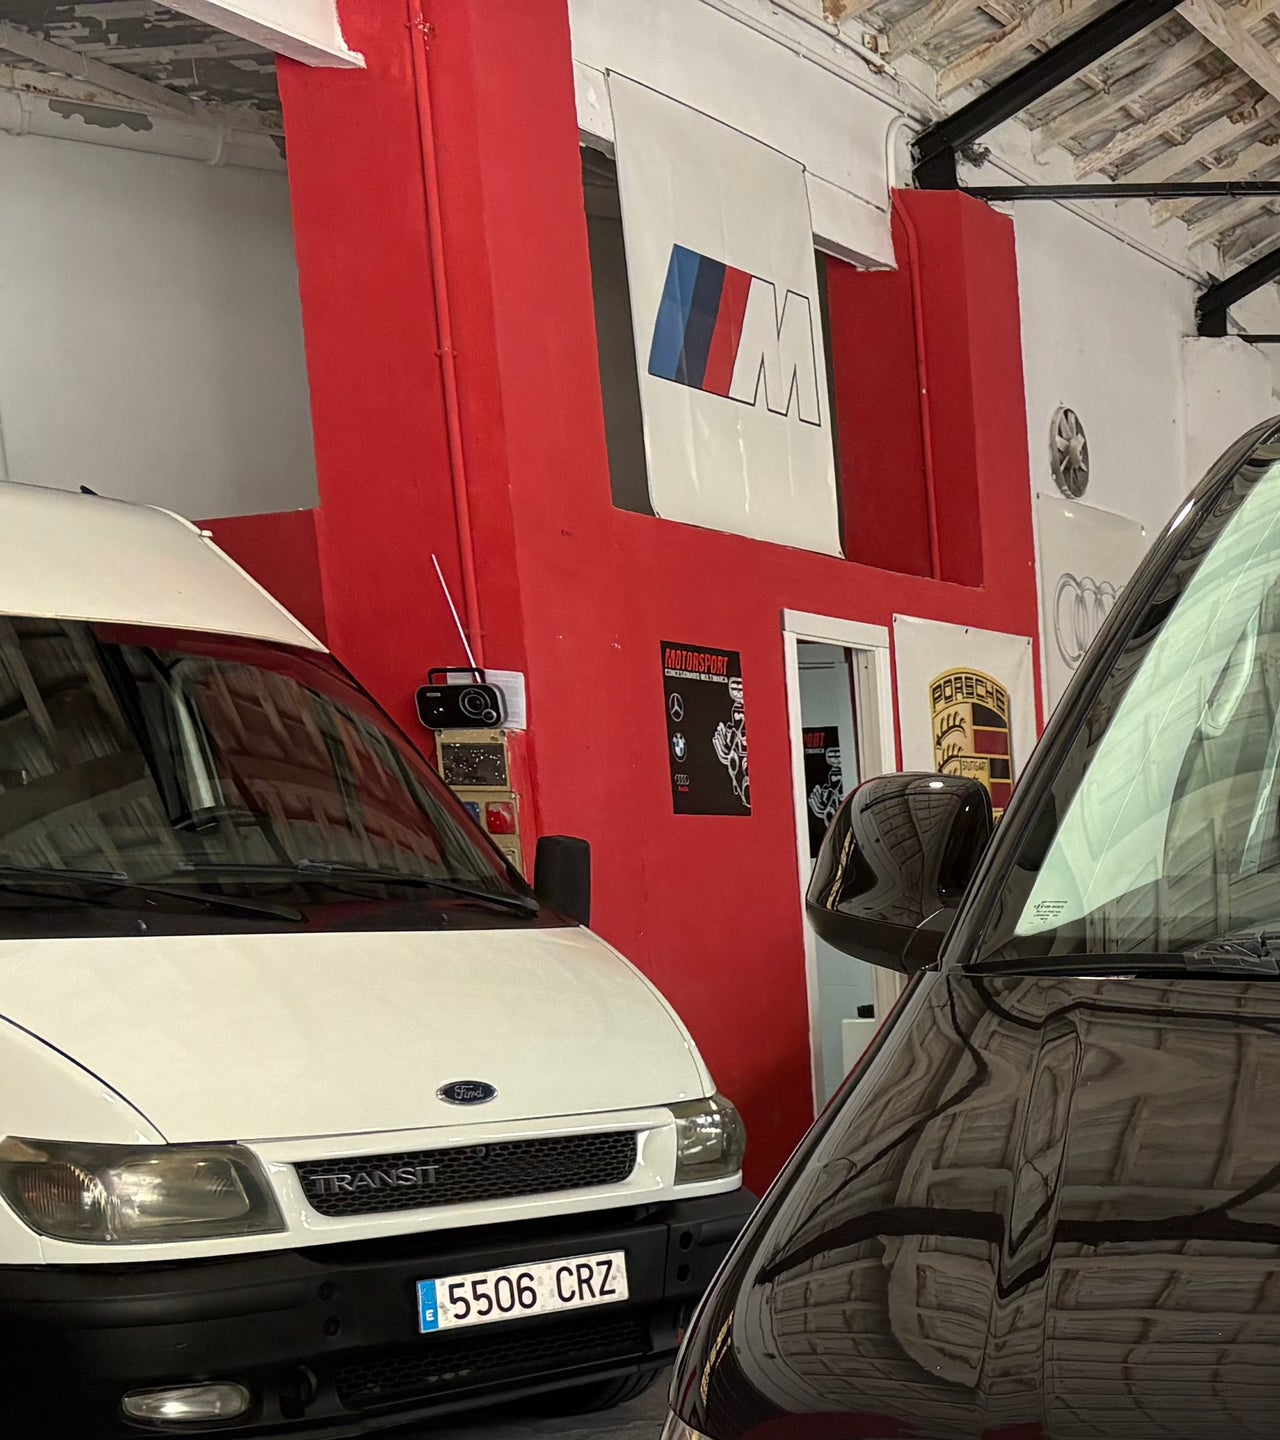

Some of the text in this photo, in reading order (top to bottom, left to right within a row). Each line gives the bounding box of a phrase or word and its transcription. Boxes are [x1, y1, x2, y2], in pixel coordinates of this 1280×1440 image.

[664, 648, 729, 675] MOTORSPORT
[932, 675, 1006, 717] PORSCHE
[453, 1085, 485, 1100] Ford
[309, 1165, 440, 1195] TRANSIT
[425, 1259, 616, 1322] E 5506 CRZ
